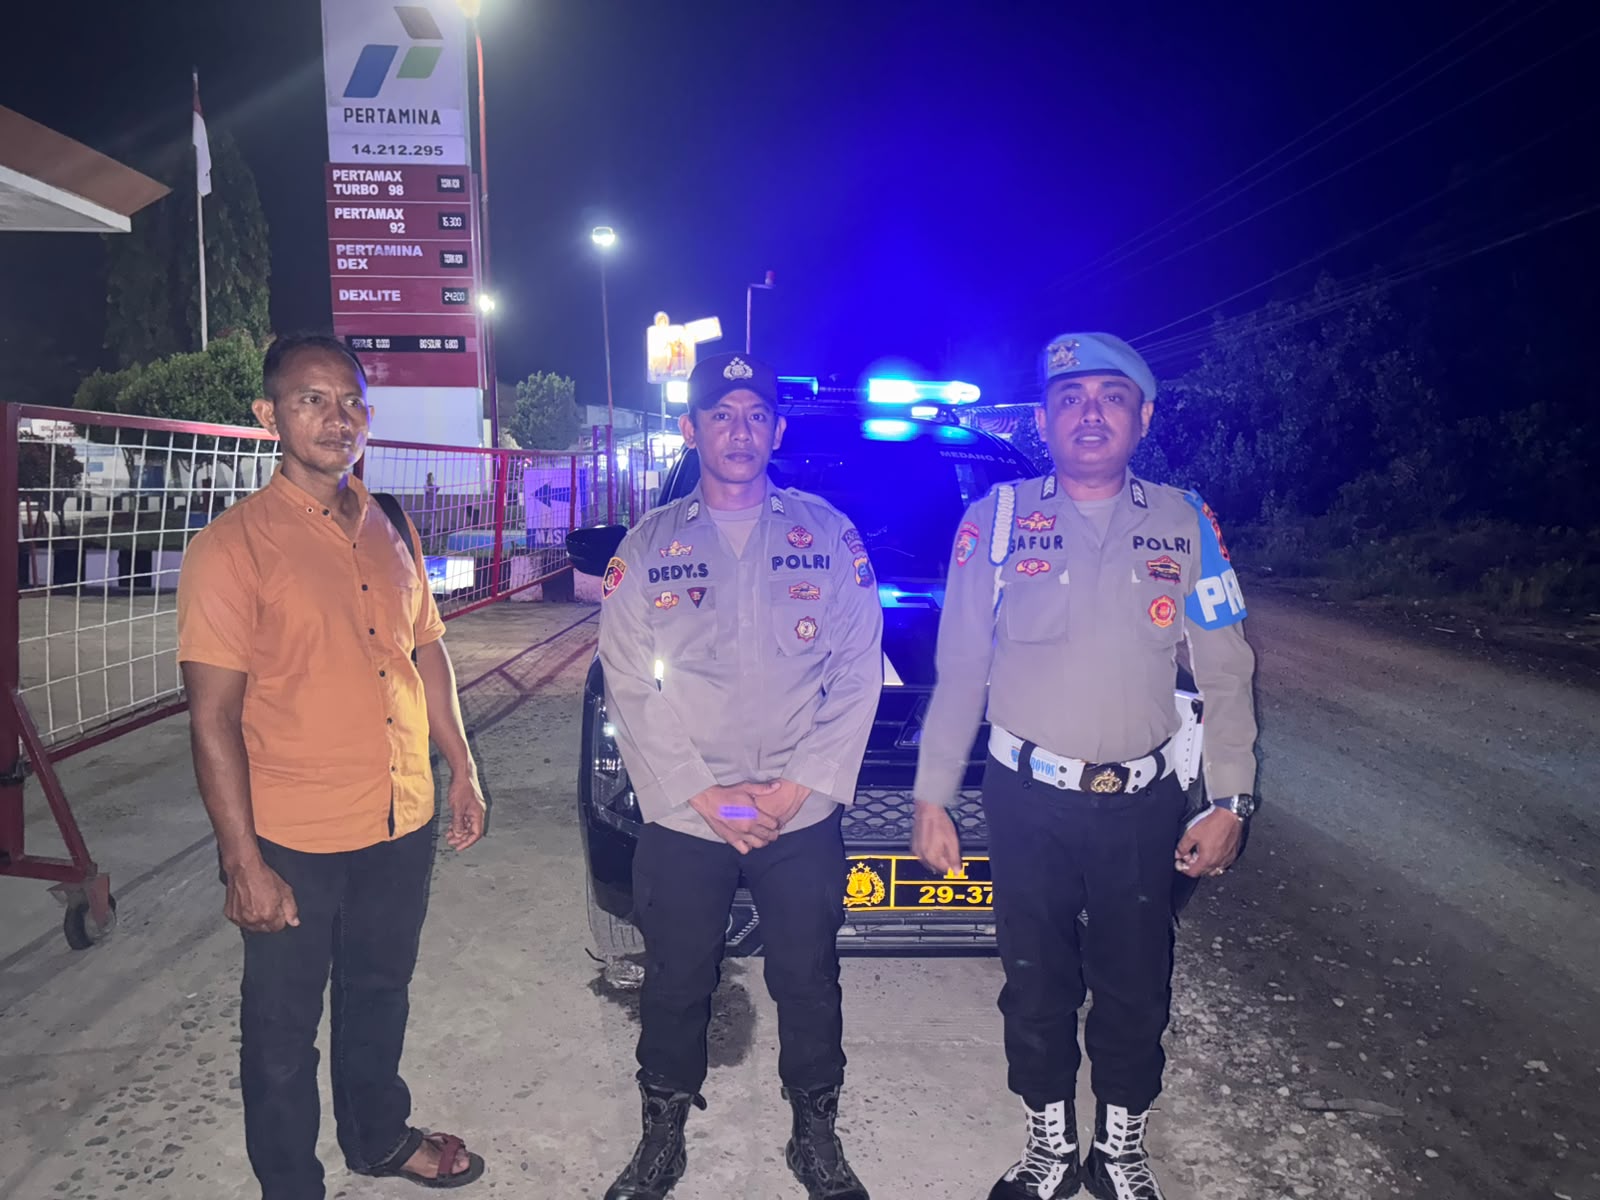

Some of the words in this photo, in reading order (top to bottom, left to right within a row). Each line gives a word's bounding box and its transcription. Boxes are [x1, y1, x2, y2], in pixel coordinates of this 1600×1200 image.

[344, 107, 441, 125] PERTAMINA
[351, 144, 444, 156] 14.212.295
[332, 169, 403, 182] PERTAMAX
[333, 184, 379, 196] TURBO
[388, 184, 404, 196] 98
[334, 207, 405, 220] PERTAMAX
[389, 222, 406, 234] 92
[336, 244, 423, 256] PERTAMINA
[337, 258, 368, 270] DEX
[338, 289, 402, 302] DEXLITE
[939, 449, 995, 462] MEDANG
[1132, 535, 1192, 555] POLRI
[771, 553, 831, 571] POLRI
[648, 562, 710, 584] DEDY.S
